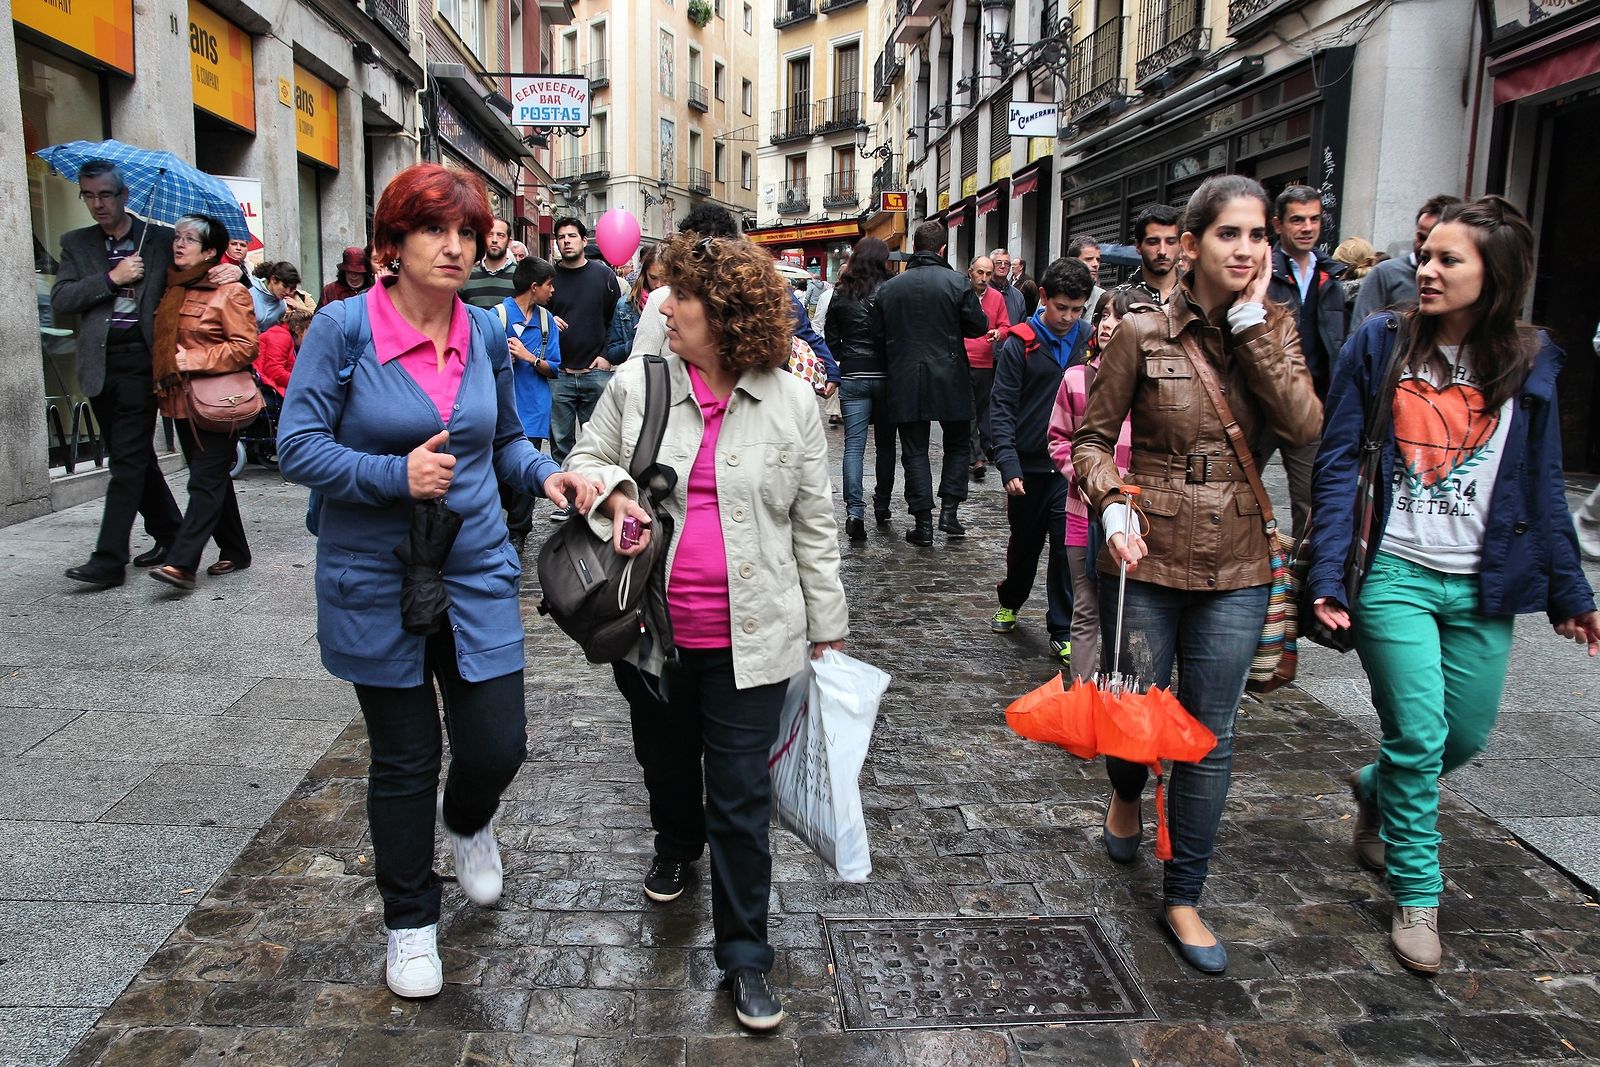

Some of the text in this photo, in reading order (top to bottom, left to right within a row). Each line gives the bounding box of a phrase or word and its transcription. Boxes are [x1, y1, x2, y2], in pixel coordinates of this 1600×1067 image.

[515, 82, 586, 103] CERVECERIA
[540, 95, 561, 105] BAR
[520, 107, 581, 120] POSTAS
